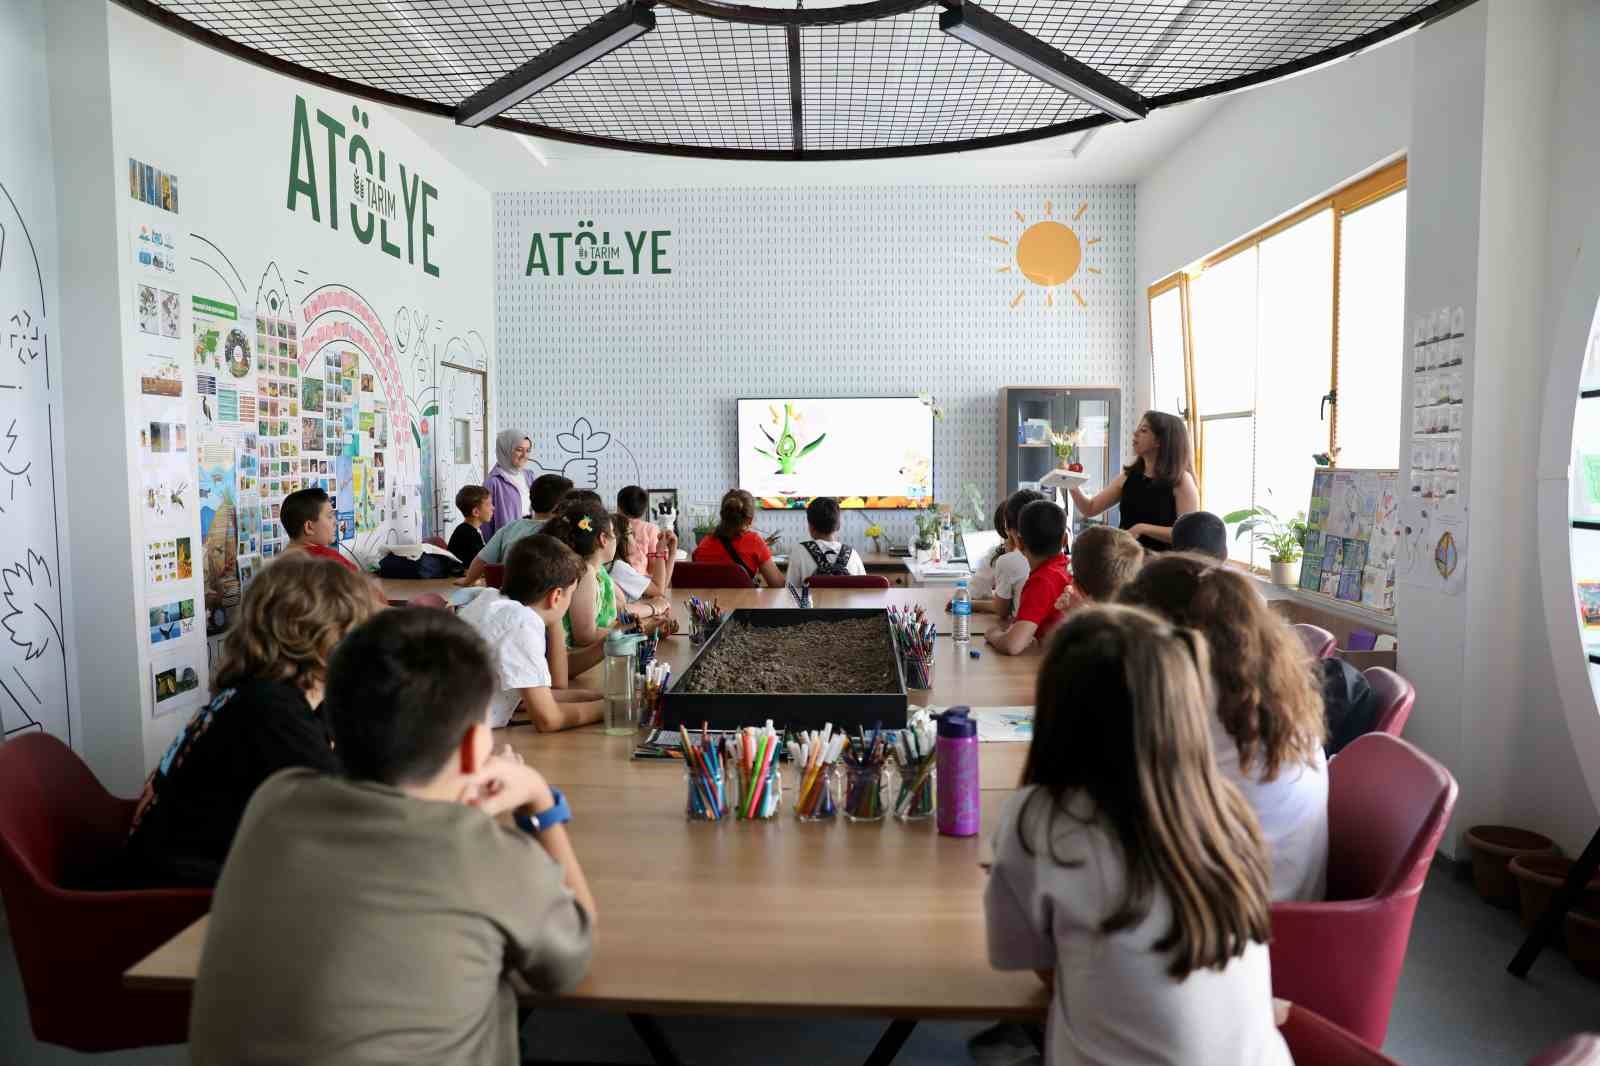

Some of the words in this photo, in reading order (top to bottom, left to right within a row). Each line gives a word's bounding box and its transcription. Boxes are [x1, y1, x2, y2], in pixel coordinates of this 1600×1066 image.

[287, 94, 440, 278] ATÖLYE
[366, 178, 397, 221] TARIM
[525, 220, 671, 276] ATÖLYE
[590, 246, 620, 259] TARIM
